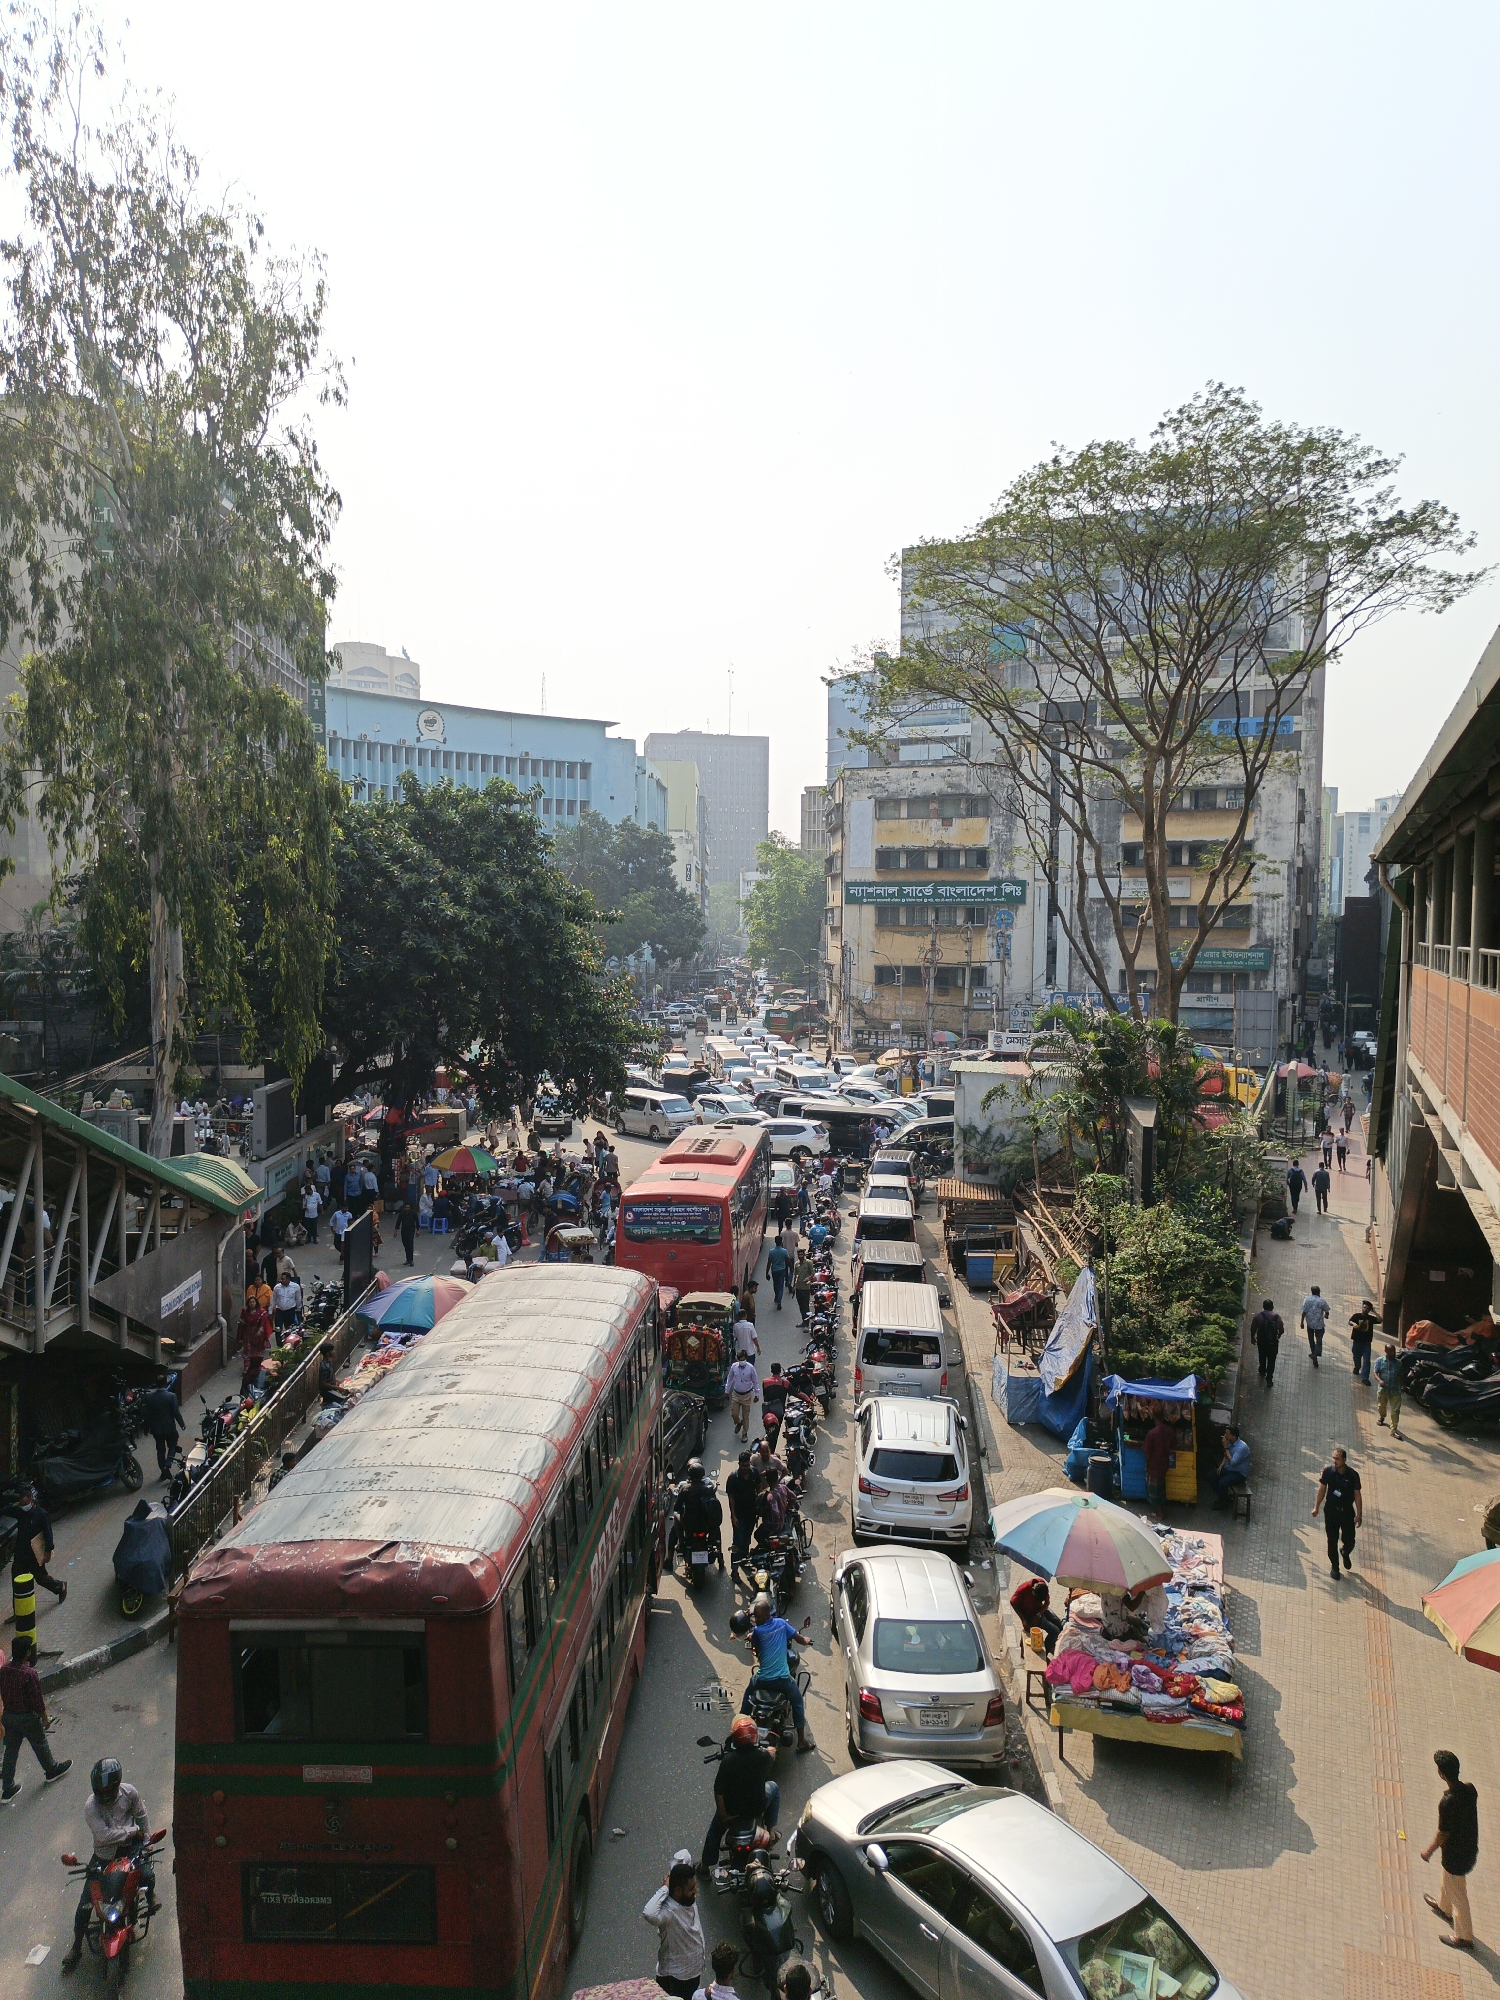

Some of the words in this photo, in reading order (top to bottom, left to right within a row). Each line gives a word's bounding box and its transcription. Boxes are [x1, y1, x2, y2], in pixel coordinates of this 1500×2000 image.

[848, 885, 899, 898] ন্যাশনাল
[902, 883, 935, 898] সার্ভে
[937, 885, 998, 898] বাংলাদেশ
[1000, 882, 1022, 897] লিঃ
